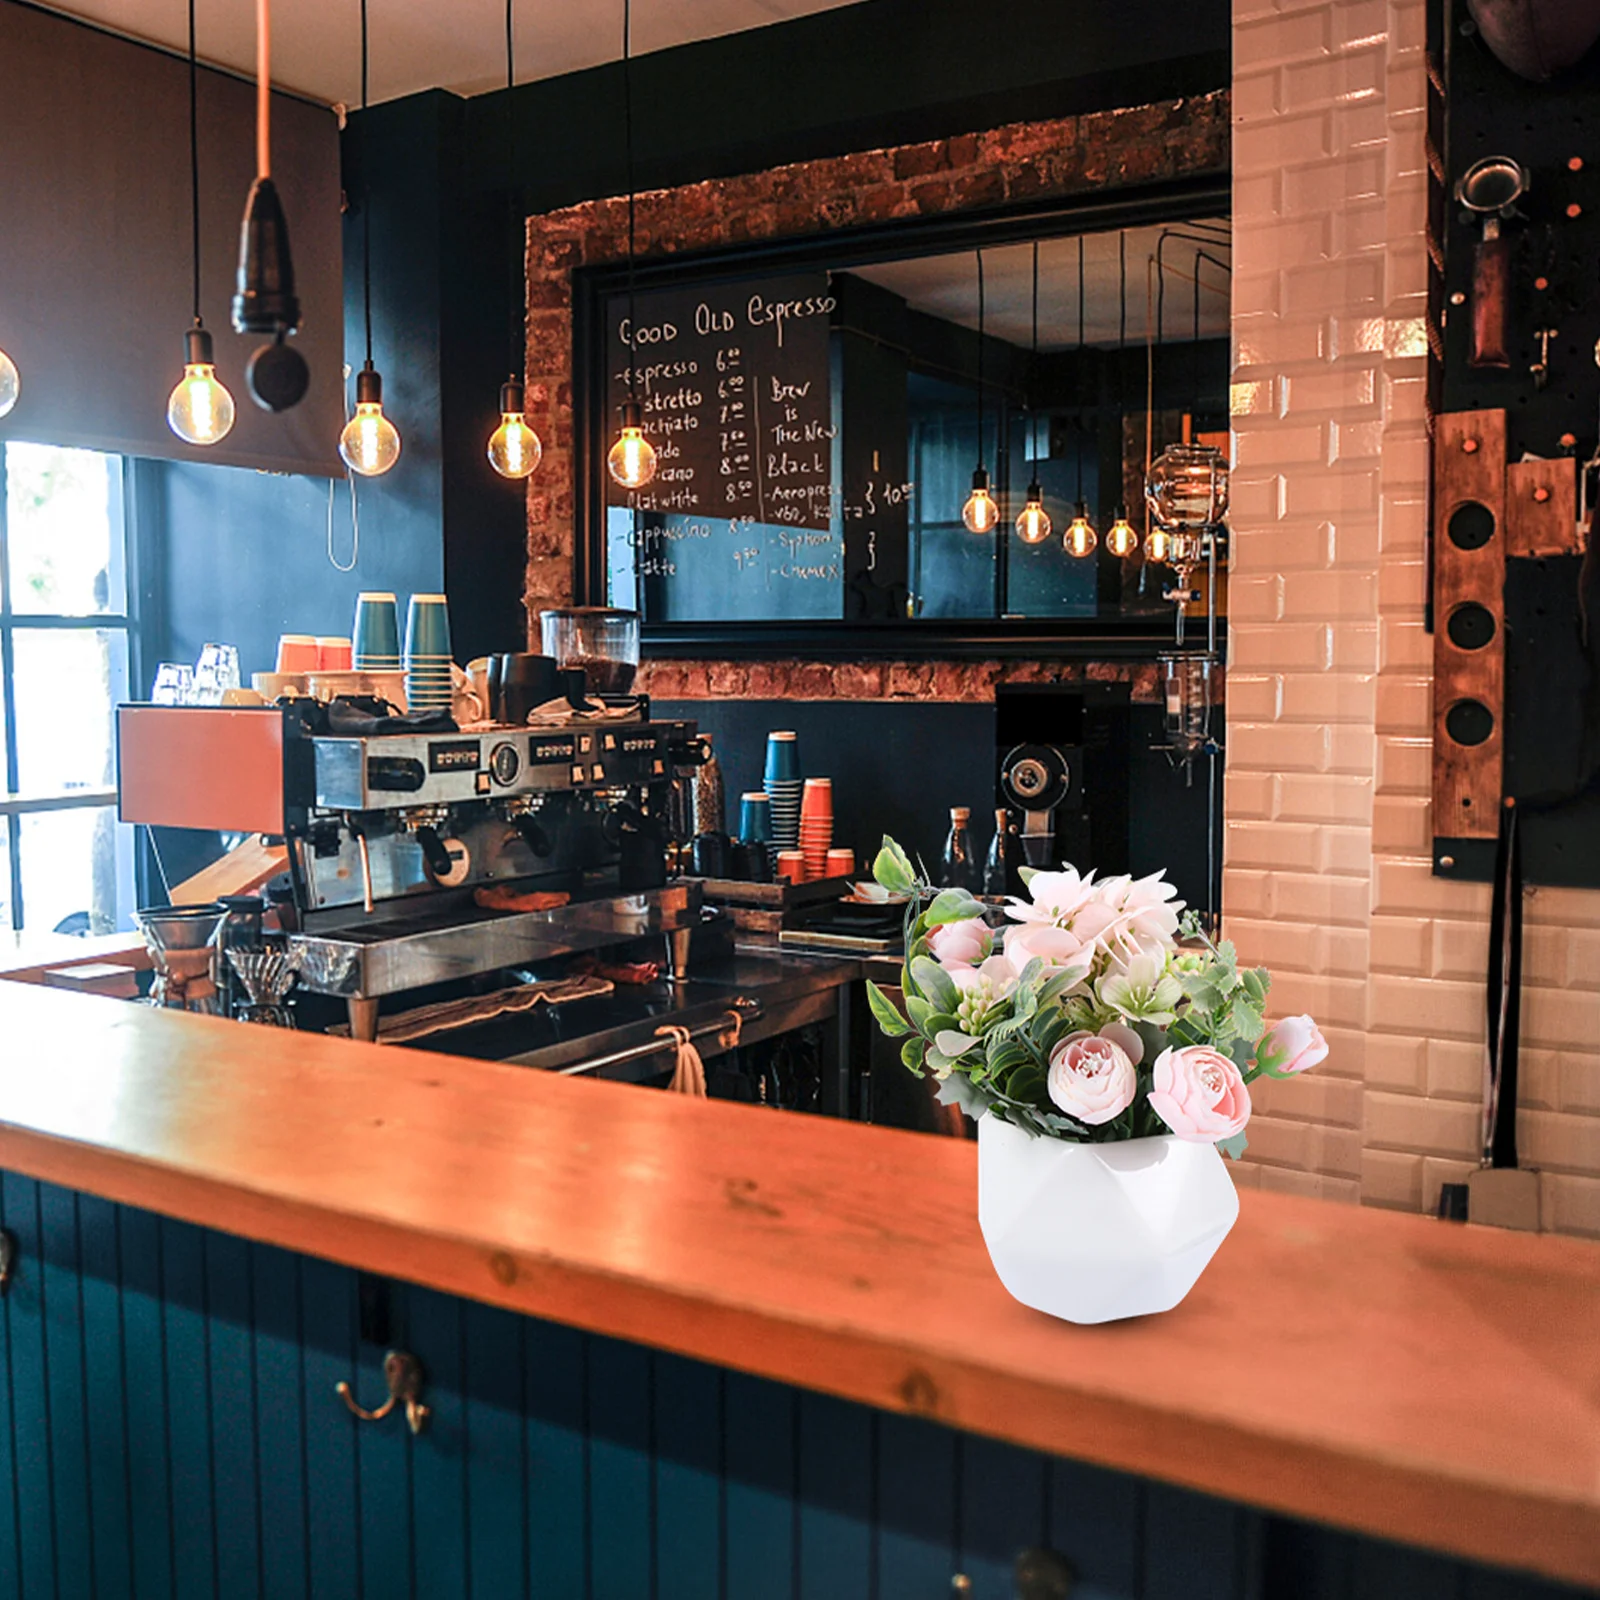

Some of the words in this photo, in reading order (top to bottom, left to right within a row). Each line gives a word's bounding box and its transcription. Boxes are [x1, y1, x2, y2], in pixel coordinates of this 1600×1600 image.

[695, 303, 735, 335] OLD
[784, 403, 799, 422] is
[767, 452, 825, 478] Black
